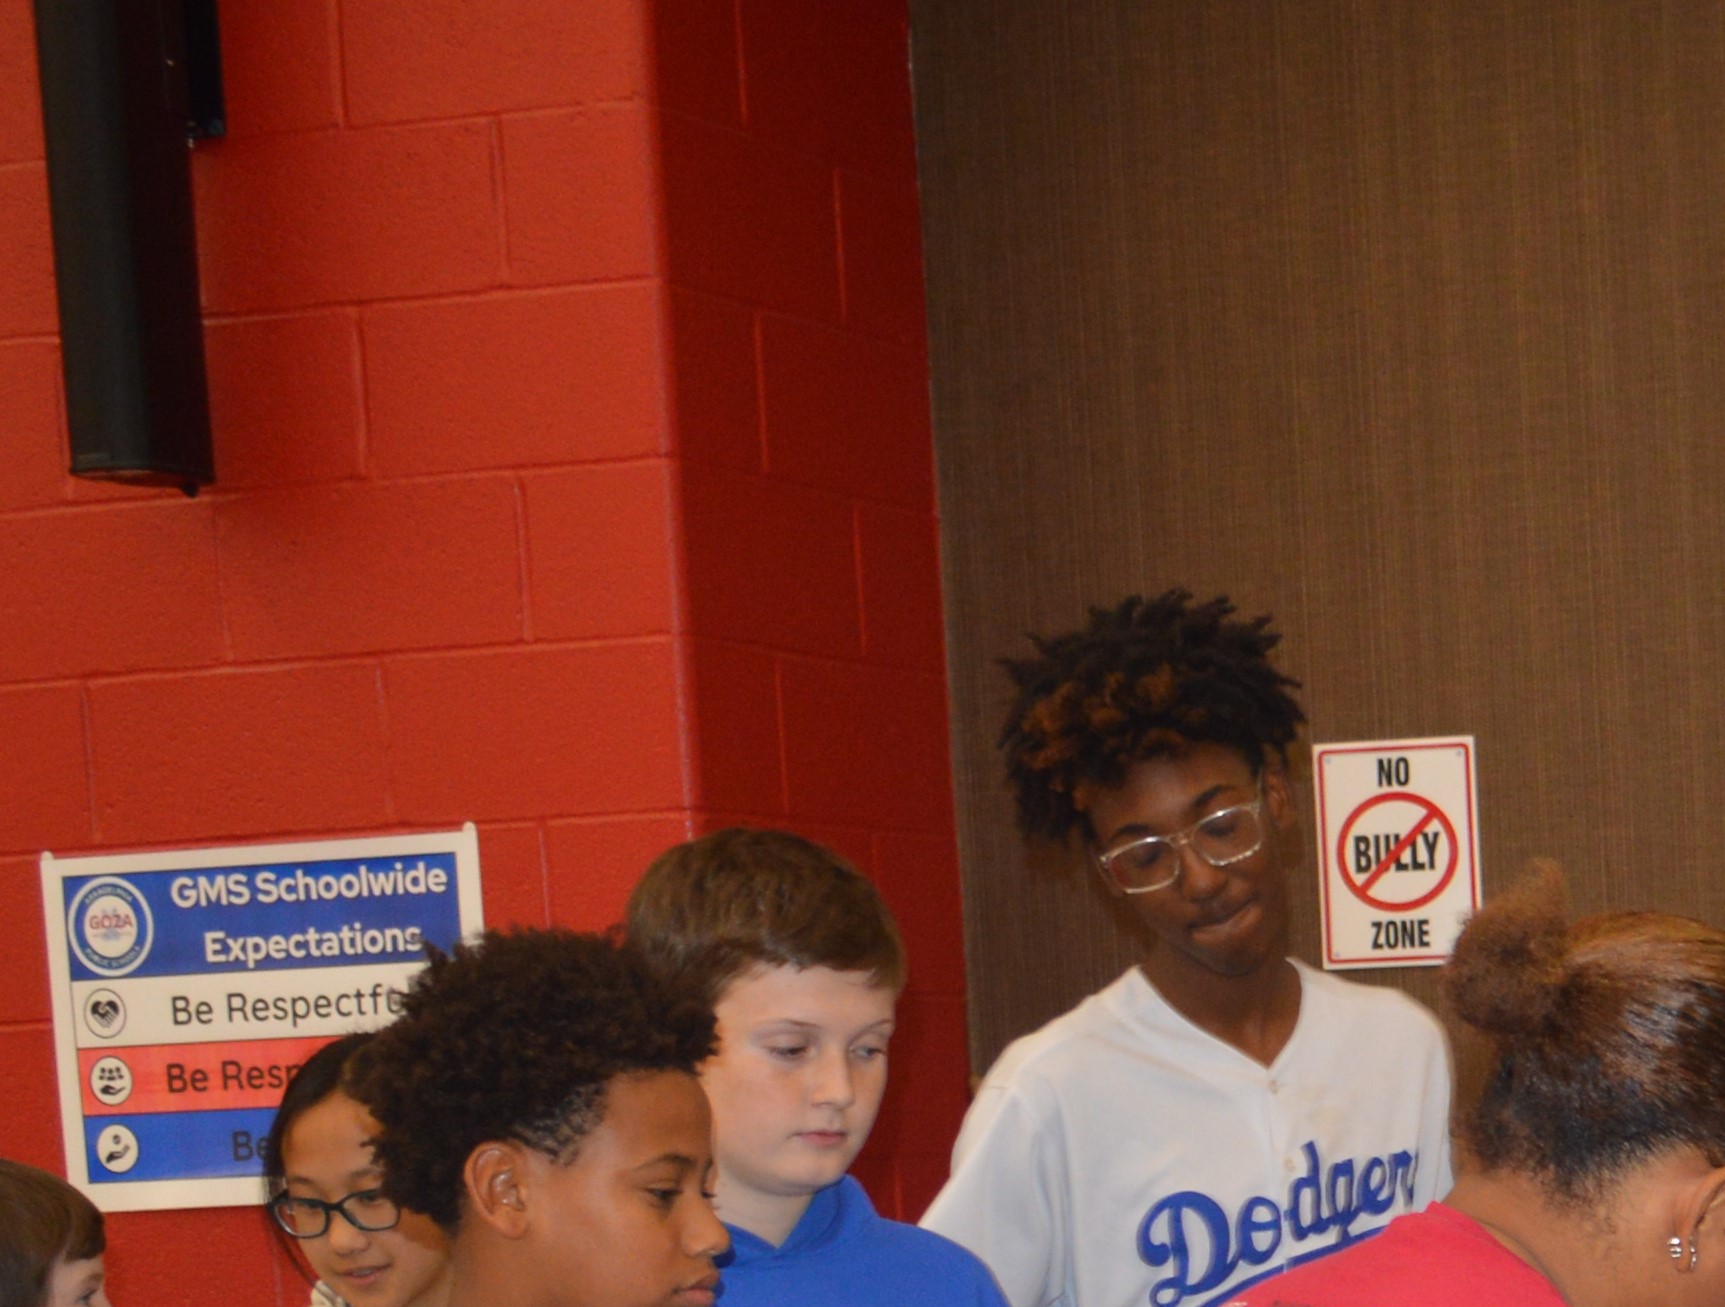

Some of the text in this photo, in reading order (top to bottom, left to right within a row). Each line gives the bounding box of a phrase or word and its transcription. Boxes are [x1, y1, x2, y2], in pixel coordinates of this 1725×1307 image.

[1377, 757, 1410, 787] NO
[1353, 831, 1440, 874] BULLY
[170, 873, 251, 909] GMS
[256, 862, 448, 903] Schoolwide
[88, 913, 134, 930] GOZA
[1371, 919, 1431, 950] ZONE
[204, 923, 423, 968] Expectations
[171, 983, 406, 1028] Be Respectfu
[165, 1063, 209, 1094] Be
